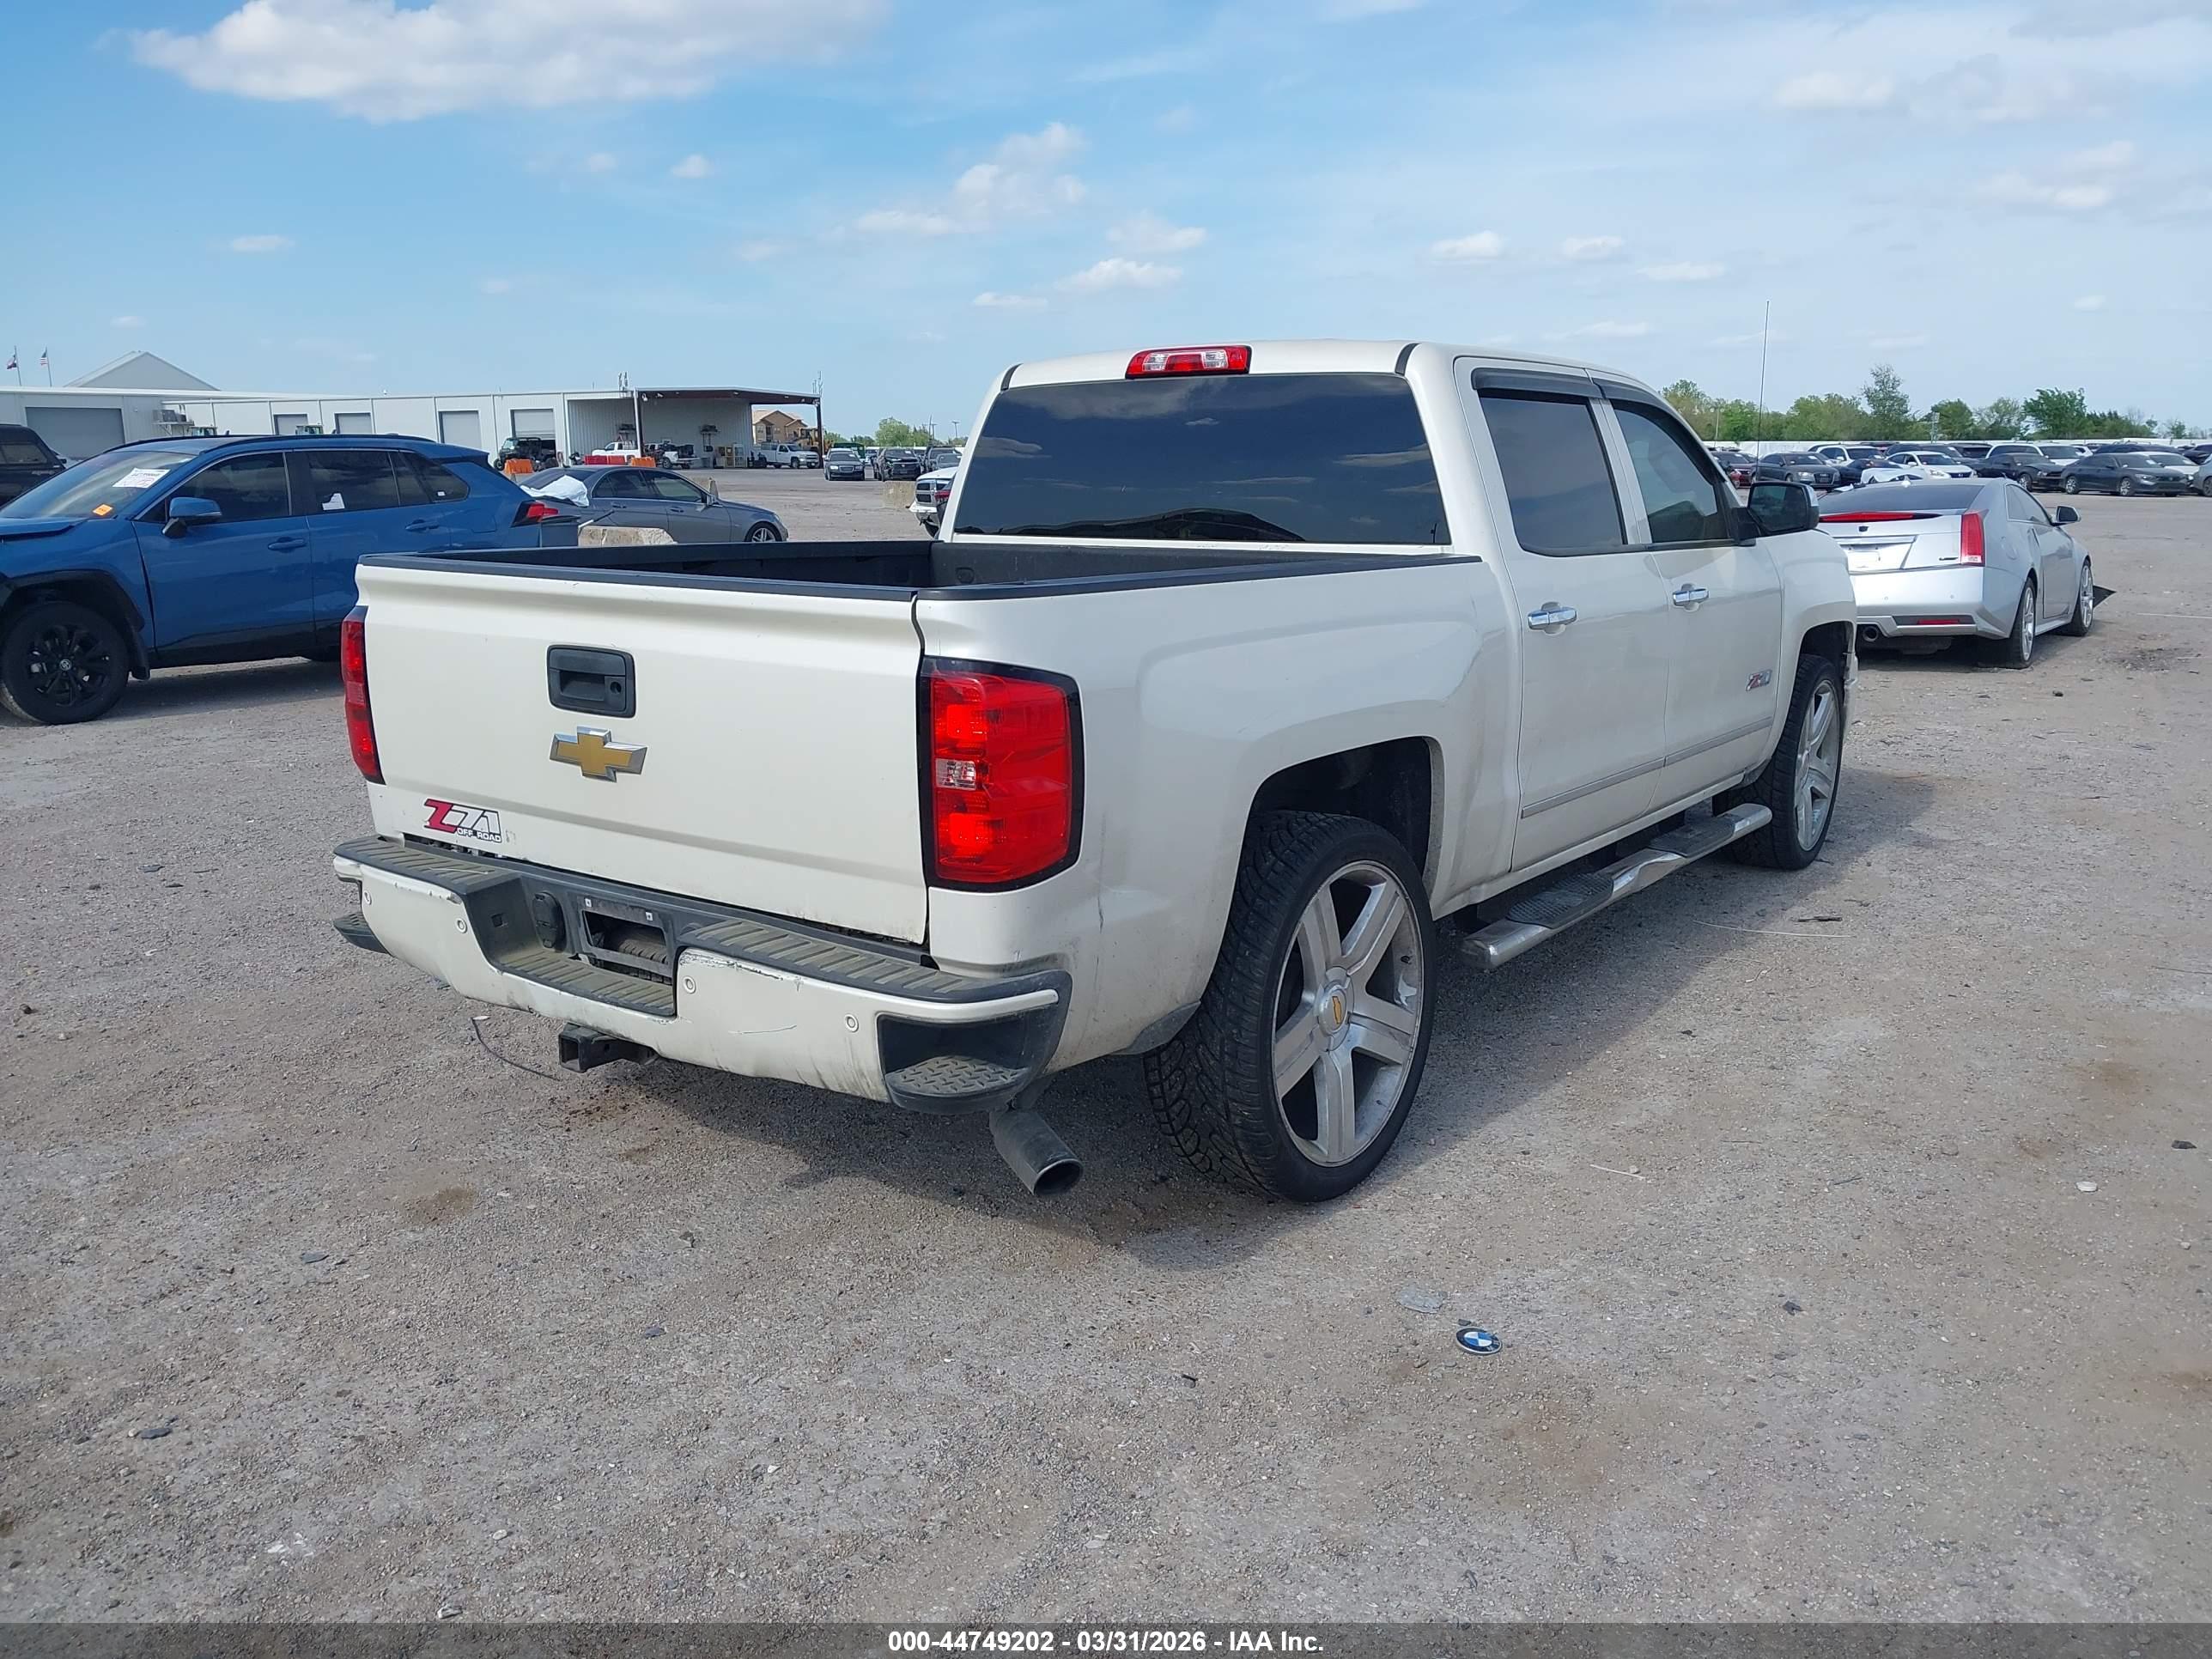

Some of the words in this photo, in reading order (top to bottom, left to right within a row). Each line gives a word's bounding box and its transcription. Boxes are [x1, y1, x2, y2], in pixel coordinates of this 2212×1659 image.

[423, 798, 501, 834] Z71
[456, 827, 473, 837] OFF
[477, 831, 501, 842] ROAD
